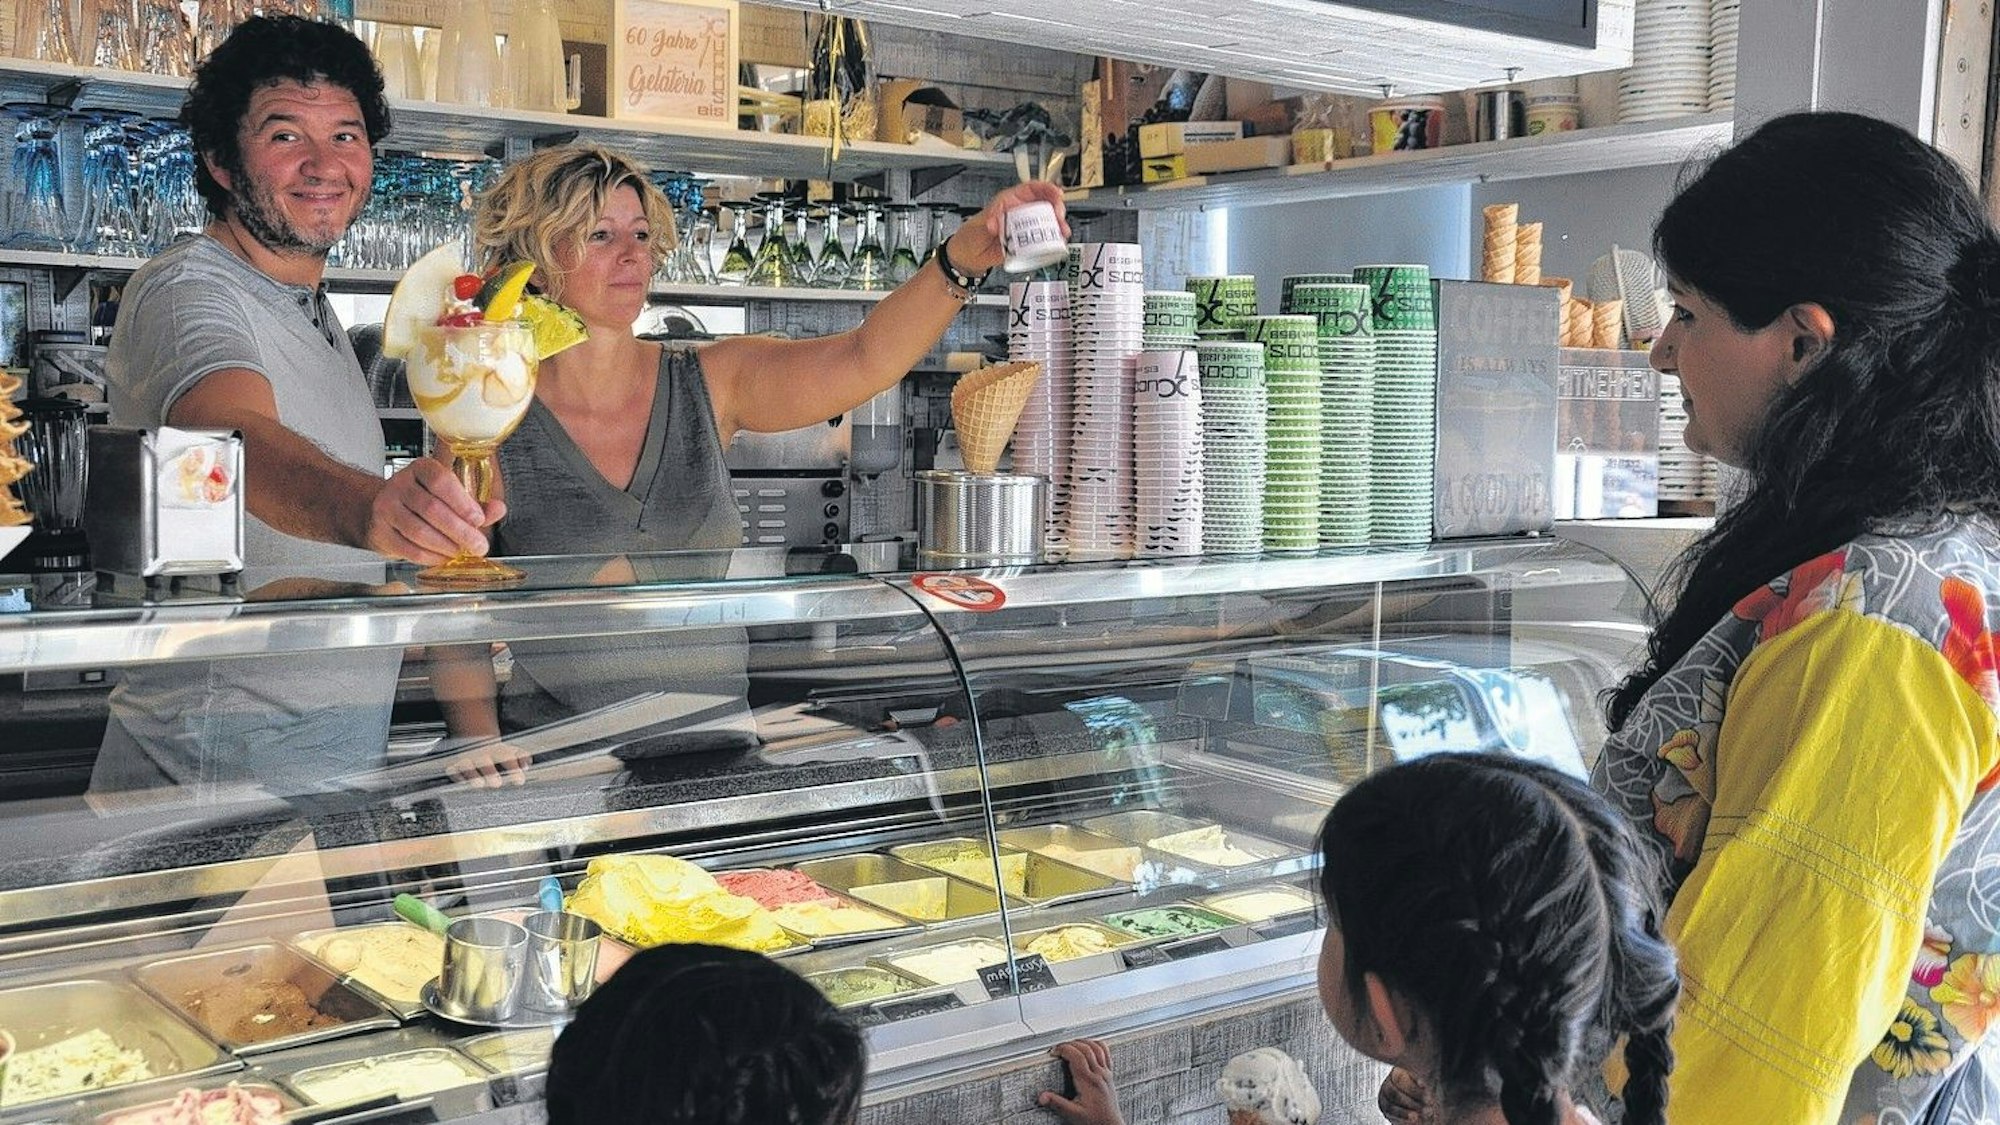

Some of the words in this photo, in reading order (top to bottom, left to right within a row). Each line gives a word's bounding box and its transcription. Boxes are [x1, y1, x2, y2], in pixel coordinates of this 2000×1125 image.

[626, 26, 648, 46] 60
[650, 28, 699, 57] Jahre
[628, 63, 707, 106] Gelateria
